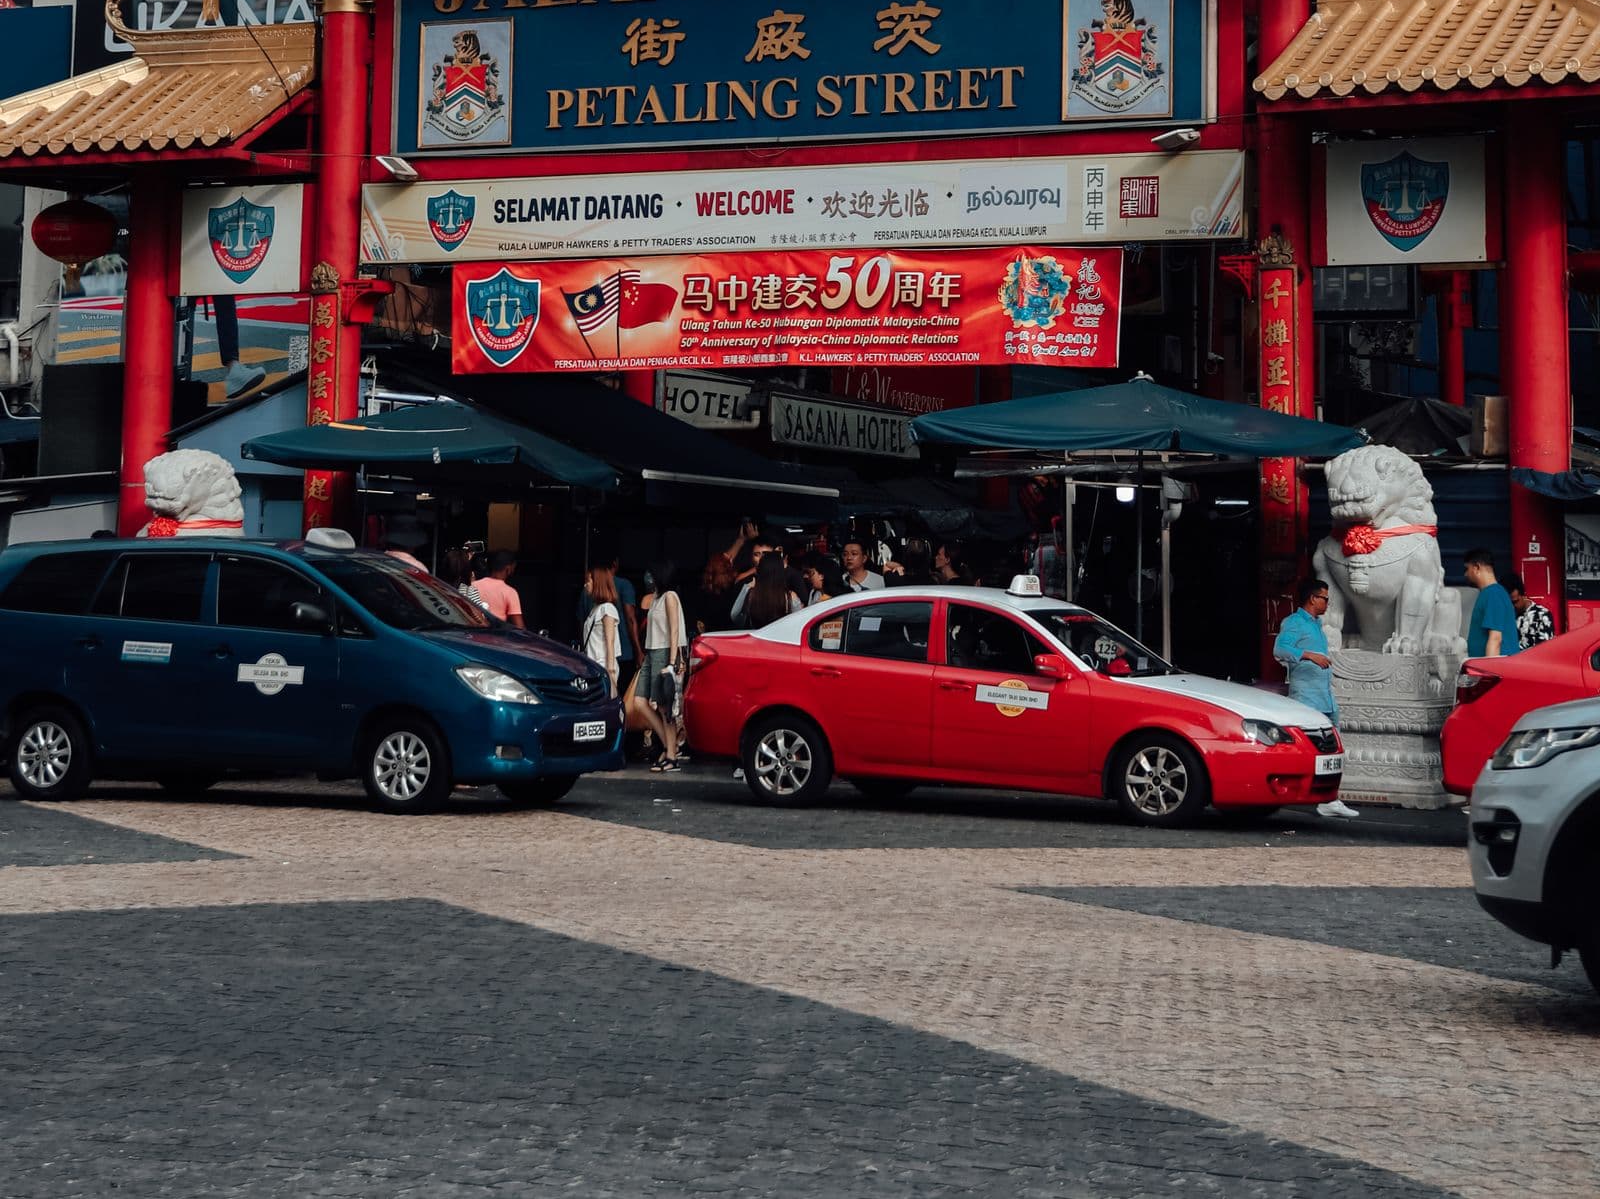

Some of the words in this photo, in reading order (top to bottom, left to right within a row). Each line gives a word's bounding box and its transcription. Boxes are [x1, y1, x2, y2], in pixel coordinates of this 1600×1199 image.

[547, 78, 799, 130] PETALING
[816, 66, 1025, 117] STREET
[494, 195, 579, 224] SELAMAT
[585, 193, 664, 221] DATANG
[695, 189, 796, 217] WELCOME
[1085, 168, 1105, 231] 丙申年
[874, 230, 909, 241] PERSATUAN
[910, 229, 938, 240] PENJAJA
[939, 228, 952, 239] DAN
[952, 228, 979, 239] PENIAGA
[980, 227, 998, 238] KECIL
[999, 227, 1020, 238] KUALA
[1021, 226, 1047, 237] LUMPUR
[498, 242, 527, 252] KUALA
[528, 241, 565, 252] LUMPUR
[614, 240, 620, 250] &
[622, 238, 649, 249] PETTY
[696, 235, 756, 246] ASSOCIATION
[681, 318, 710, 333] Ulang
[713, 317, 743, 330] Tahun
[746, 317, 771, 330] Ke-50
[774, 316, 823, 331] Hubungan
[825, 316, 881, 331] Diplomatik
[883, 316, 960, 331] Malaysia-China
[701, 336, 760, 349] Anniversary
[761, 335, 772, 348] of
[774, 334, 851, 348] Malaysia-China
[853, 333, 908, 347] Diplomatic
[911, 332, 959, 345] Relations
[554, 358, 597, 368] PERSATUAN
[598, 358, 629, 368] PENJAJA
[630, 357, 645, 367] DAN
[646, 357, 678, 367] PENIAGA
[679, 356, 699, 366] KECIL
[856, 352, 863, 361] &
[864, 352, 888, 361] PETTY
[928, 351, 980, 361] ASSOCIATION
[666, 386, 745, 421] HOTEL
[784, 403, 850, 448] SASANA
[856, 408, 906, 454] HOTEL
[1098, 643, 1118, 655] 129
[987, 691, 1007, 699] ELEGANT
